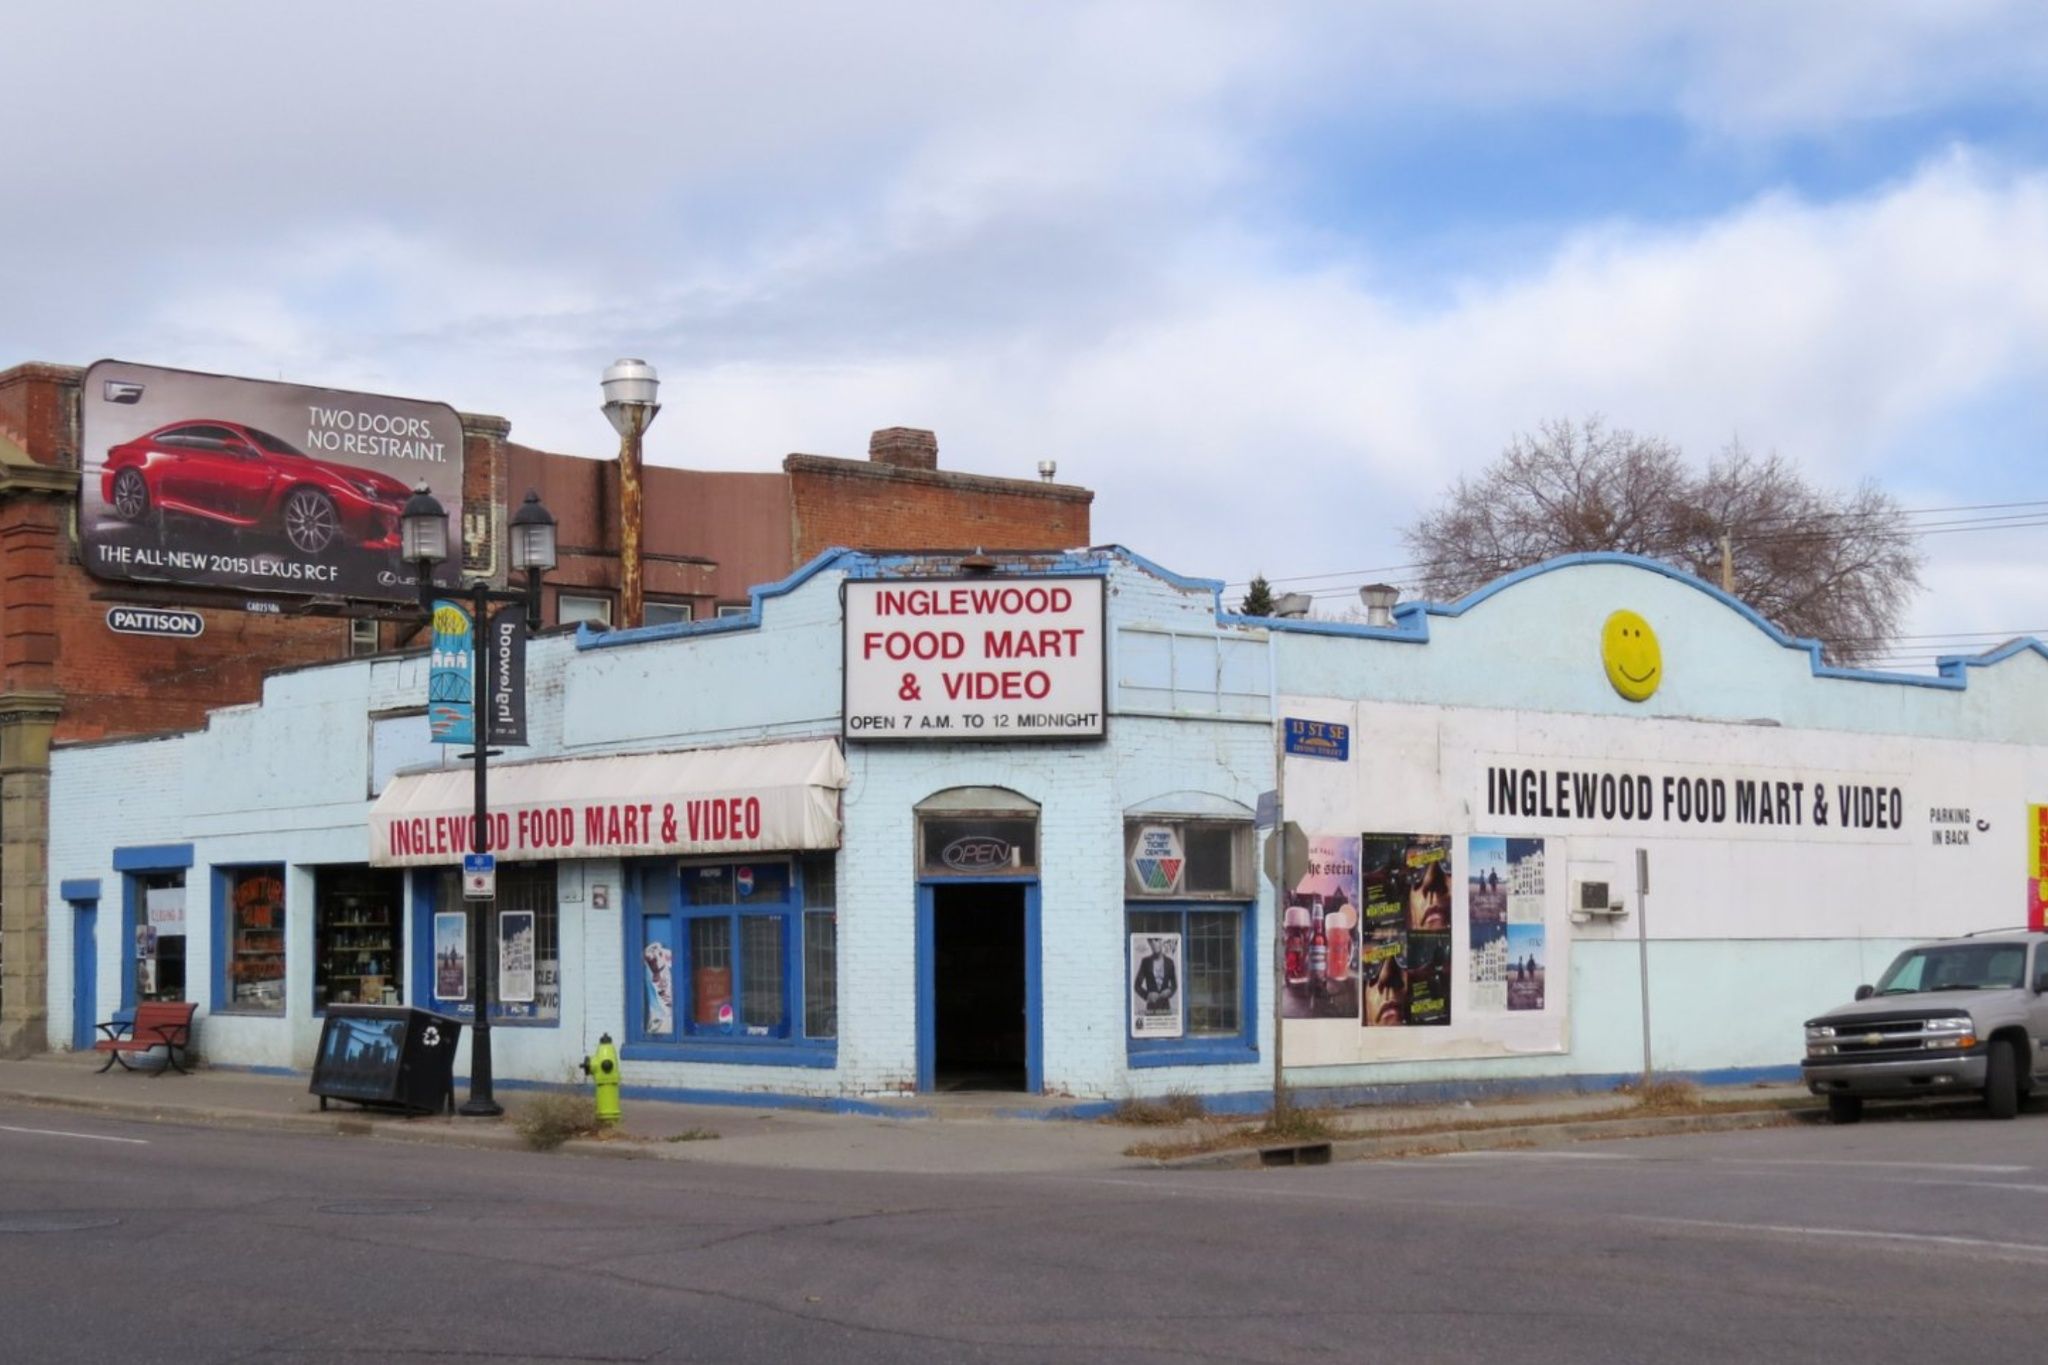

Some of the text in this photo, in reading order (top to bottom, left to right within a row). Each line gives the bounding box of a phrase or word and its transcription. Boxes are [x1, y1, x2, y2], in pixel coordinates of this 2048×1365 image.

[309, 406, 434, 440] TWO DOORS.
[308, 430, 446, 463] NO RESTRAINT.
[99, 545, 131, 564] THE
[135, 549, 207, 569] ALL-NEW
[211, 555, 249, 574] 2015
[250, 558, 300, 579] LEXUS
[875, 588, 1072, 616] INGLEWOOD
[114, 611, 196, 632] PATTISON
[863, 629, 1084, 660] FOOD MART
[898, 670, 1051, 701] & VIDEO
[850, 713, 1098, 729] OPEN 7 A.M. TO 12 MIDNIGHT
[1309, 723, 1325, 736] ST
[1329, 726, 1345, 739] SE
[1488, 767, 1902, 829] INGLEWOOD FOOD MART & VIDEO
[518, 808, 574, 848] FOOD
[585, 804, 652, 845] MART
[661, 803, 677, 842] &
[686, 797, 761, 841] VIDEO
[1930, 808, 1971, 824] PARKING
[1144, 832, 1171, 840] LOTTERY
[1932, 831, 1970, 845] IN BACK
[948, 844, 1009, 863] OPEN
[1324, 861, 1353, 875] stein
